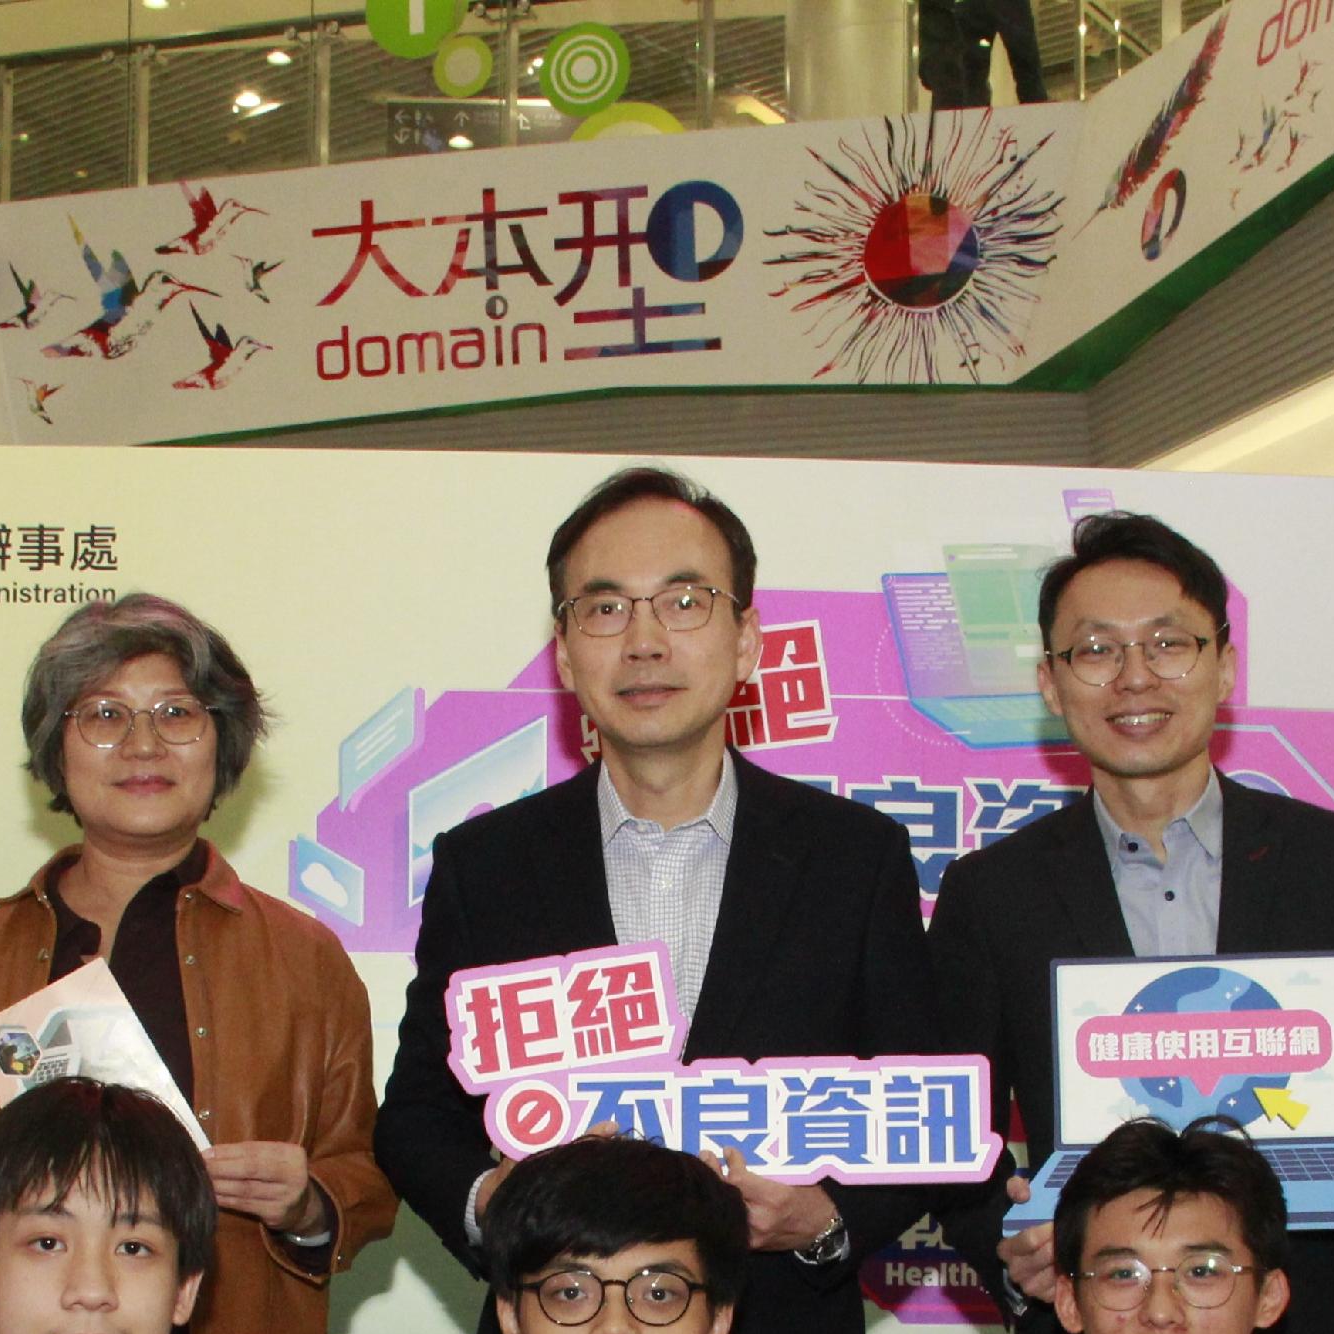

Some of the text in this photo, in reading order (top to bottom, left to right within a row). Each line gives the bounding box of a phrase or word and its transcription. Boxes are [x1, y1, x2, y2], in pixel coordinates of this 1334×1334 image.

[311, 179, 745, 361] 大本型
[315, 294, 548, 381] domain
[466, 960, 665, 1075] 拒絕
[1088, 1026, 1321, 1062] 健康使用互聯網
[573, 1074, 981, 1166] 不良資訊
[885, 1262, 990, 1294] Health
